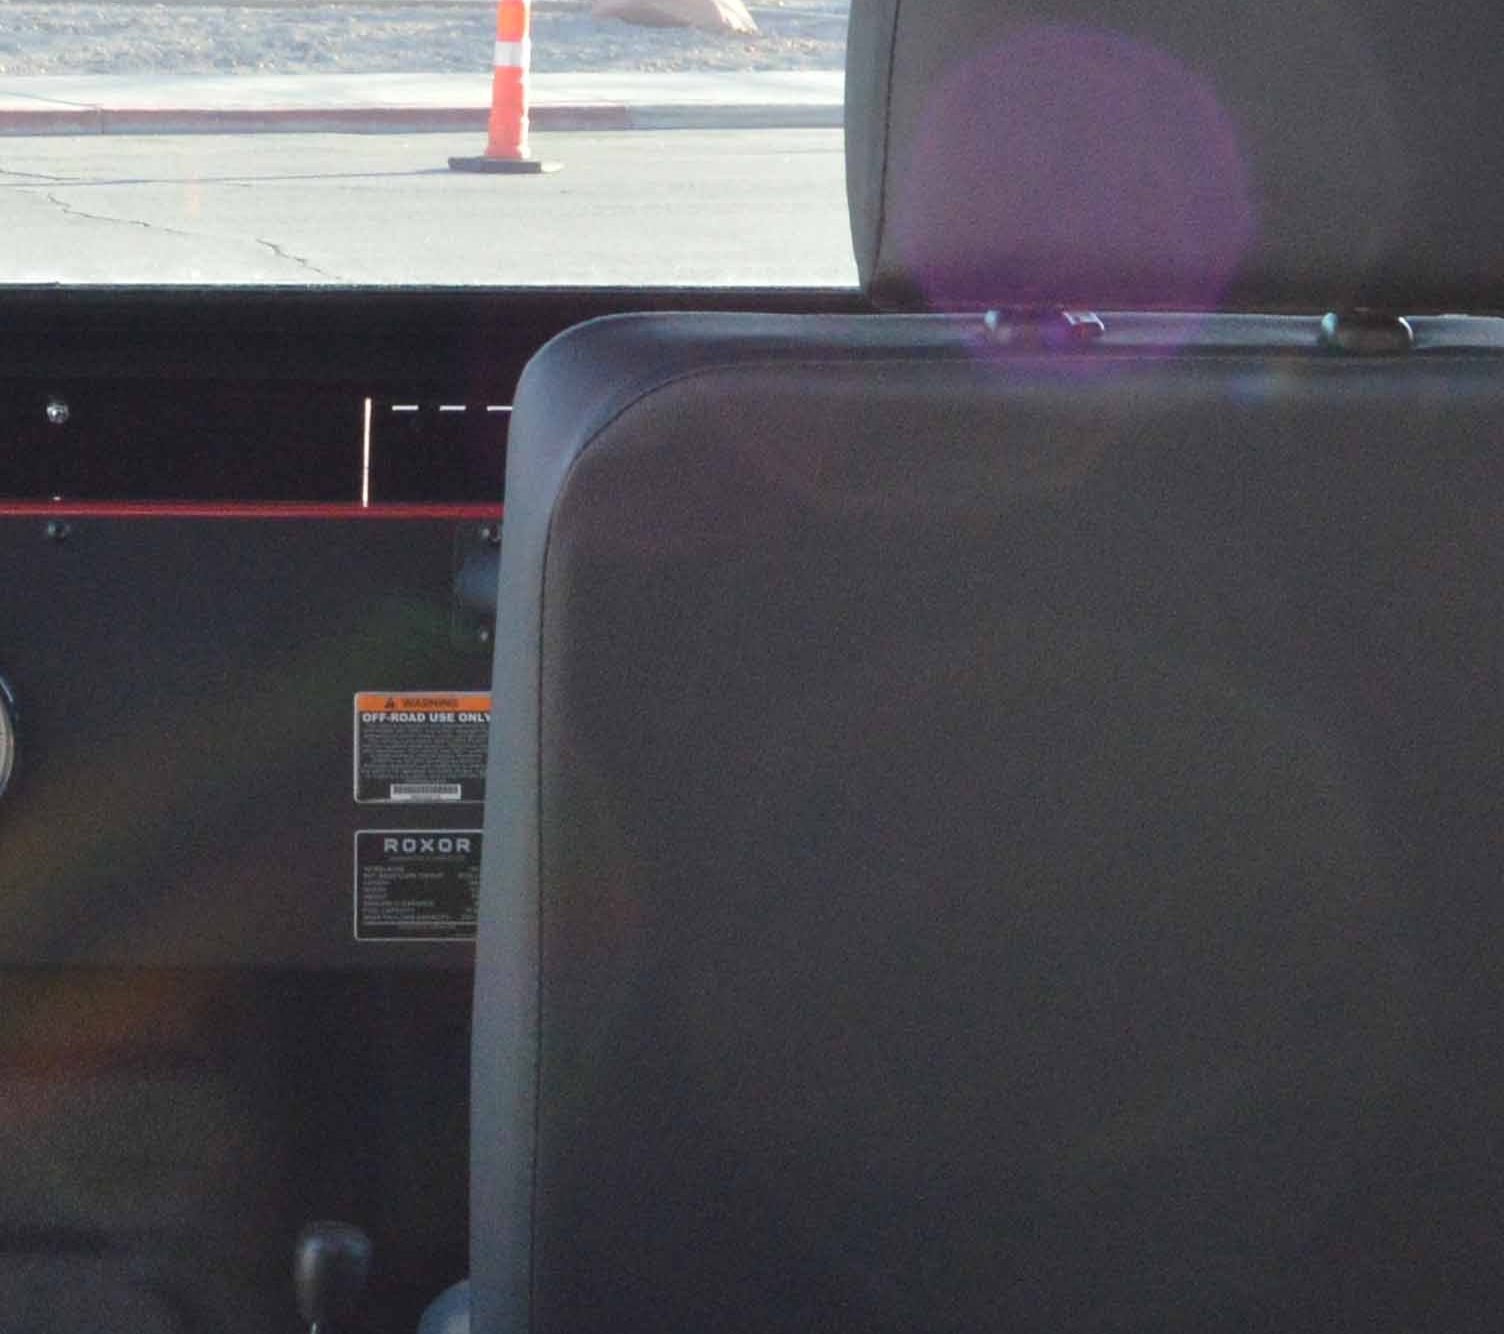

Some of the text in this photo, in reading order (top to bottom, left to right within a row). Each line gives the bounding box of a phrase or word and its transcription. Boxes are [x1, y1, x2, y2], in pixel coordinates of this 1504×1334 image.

[362, 712, 492, 724] OFF-ROAD USE ONLY
[383, 837, 472, 853] ROXOR
